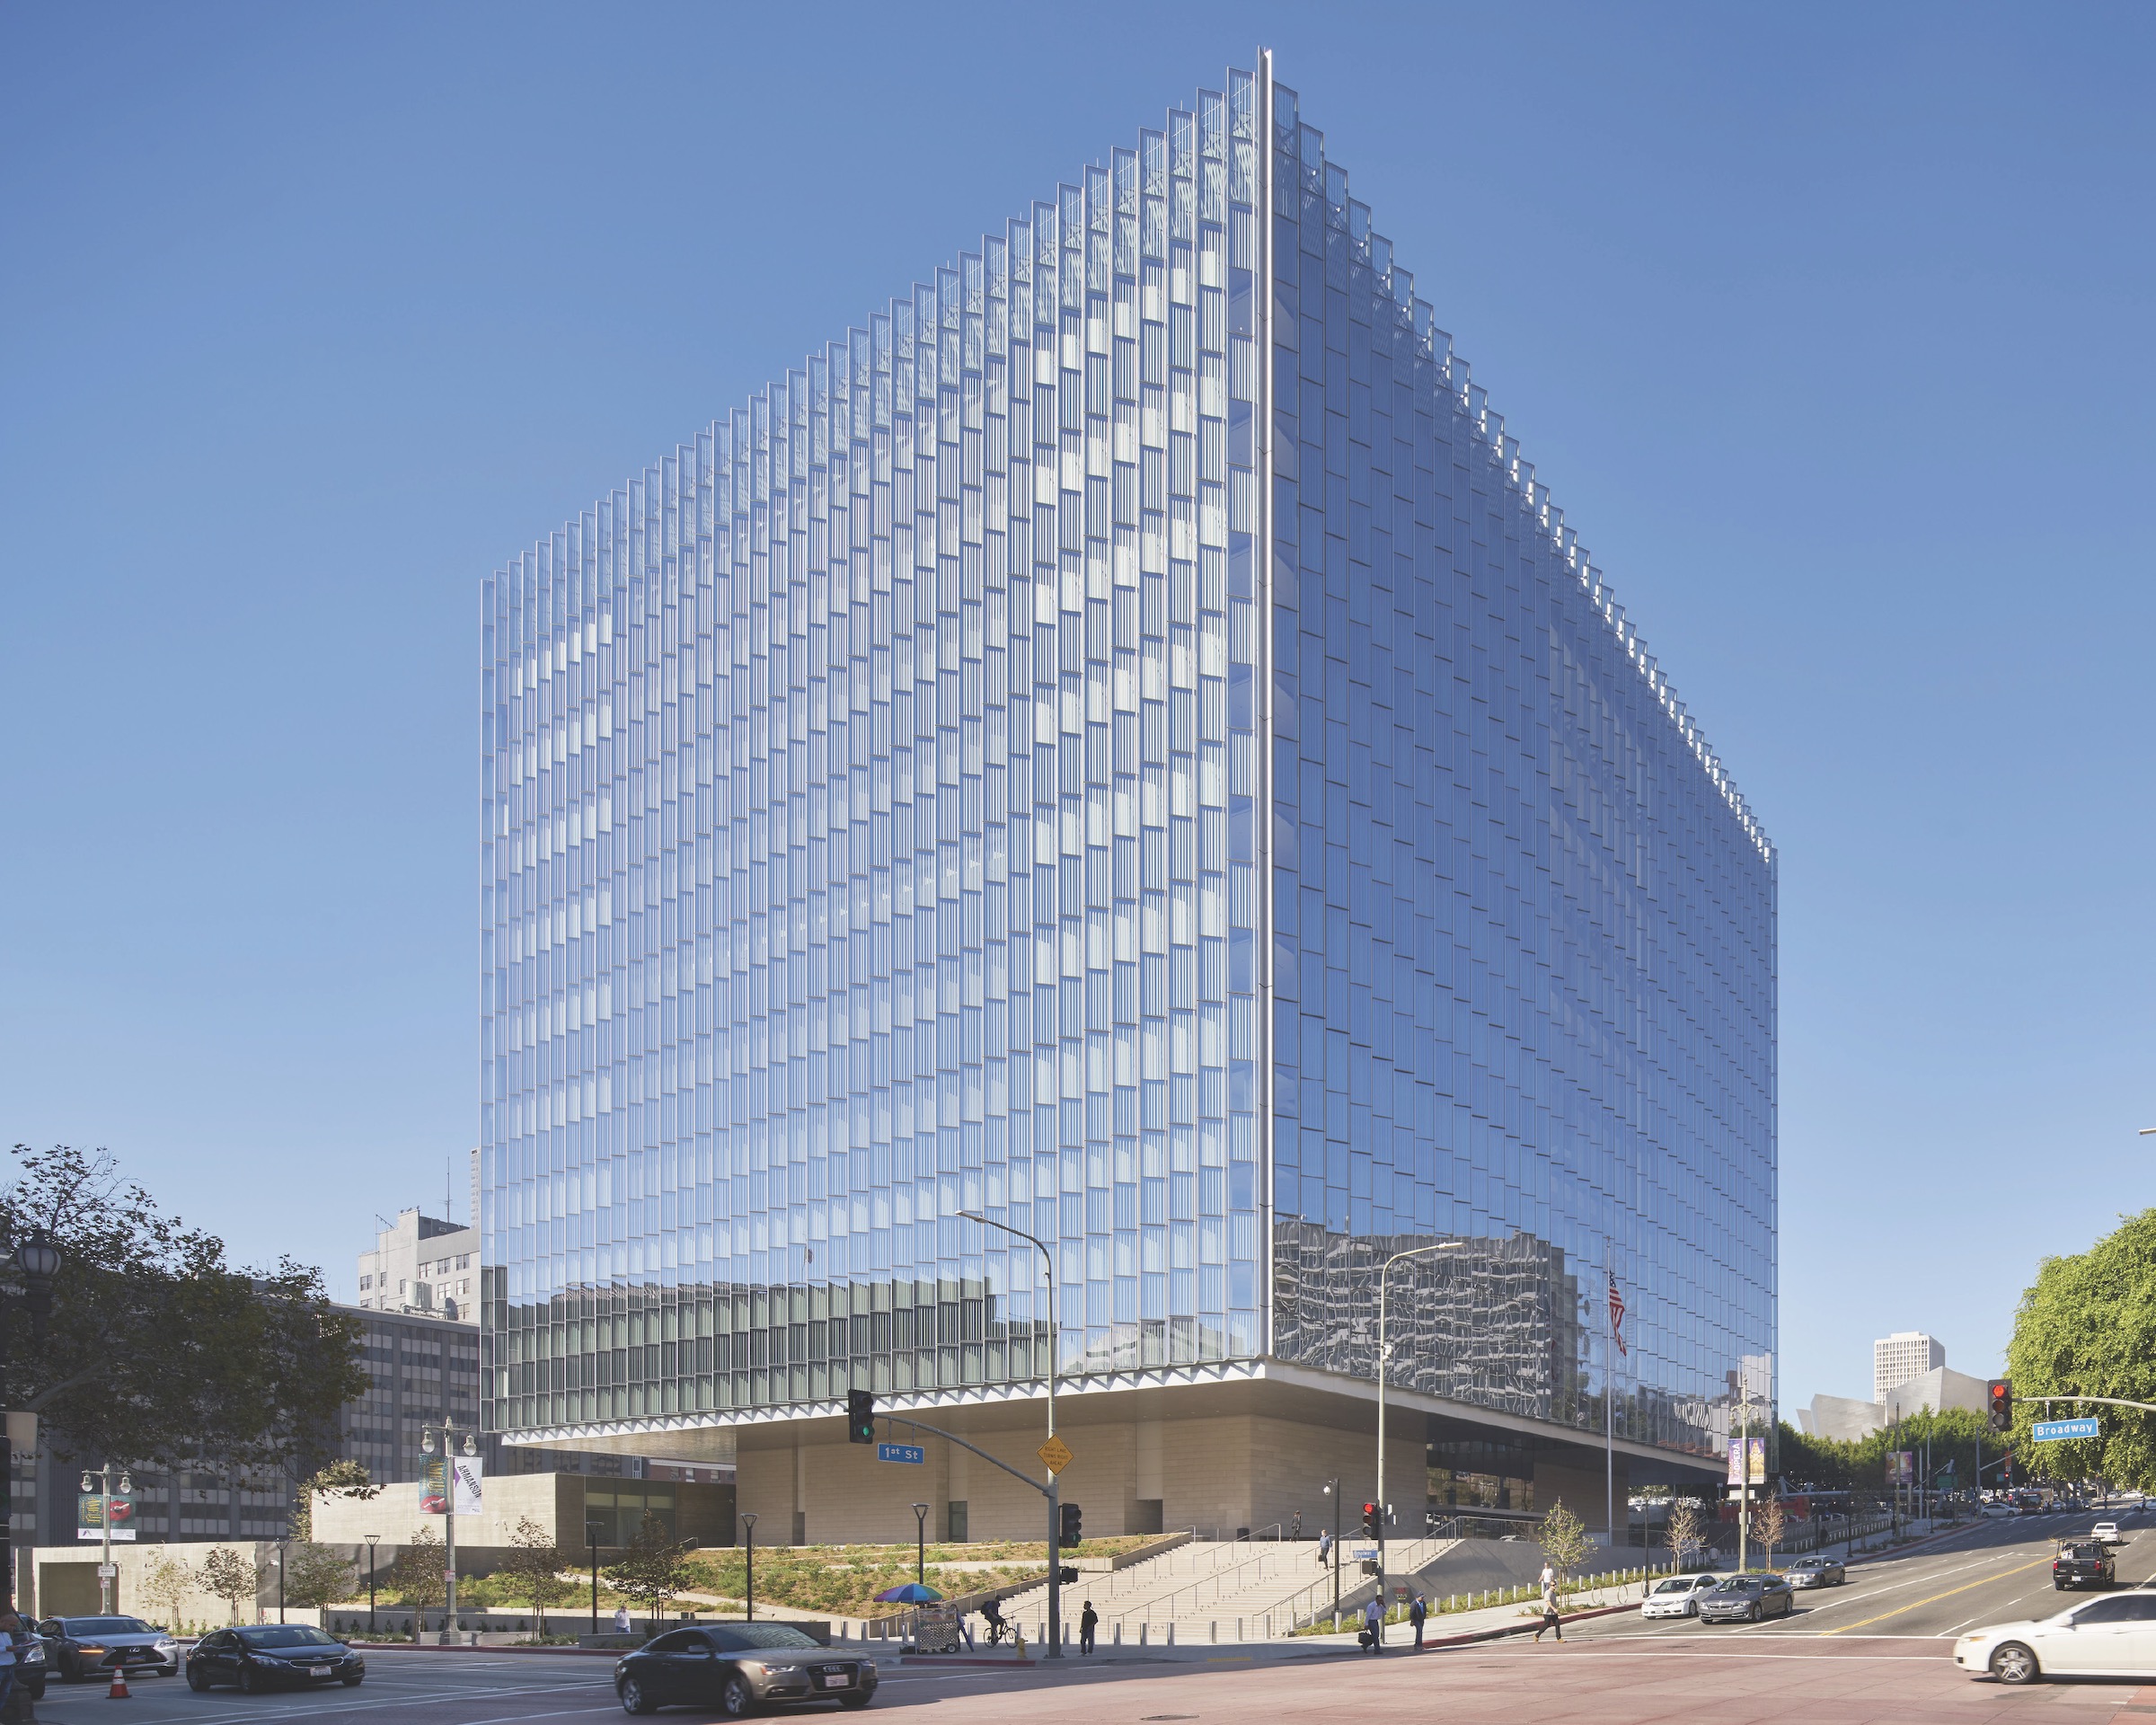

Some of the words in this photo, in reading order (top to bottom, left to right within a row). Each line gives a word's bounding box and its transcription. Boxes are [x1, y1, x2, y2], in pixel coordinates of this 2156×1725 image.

[2037, 1423, 2093, 1437] Broadway
[885, 1446, 900, 1458] 1st
[905, 1449, 918, 1460] St
